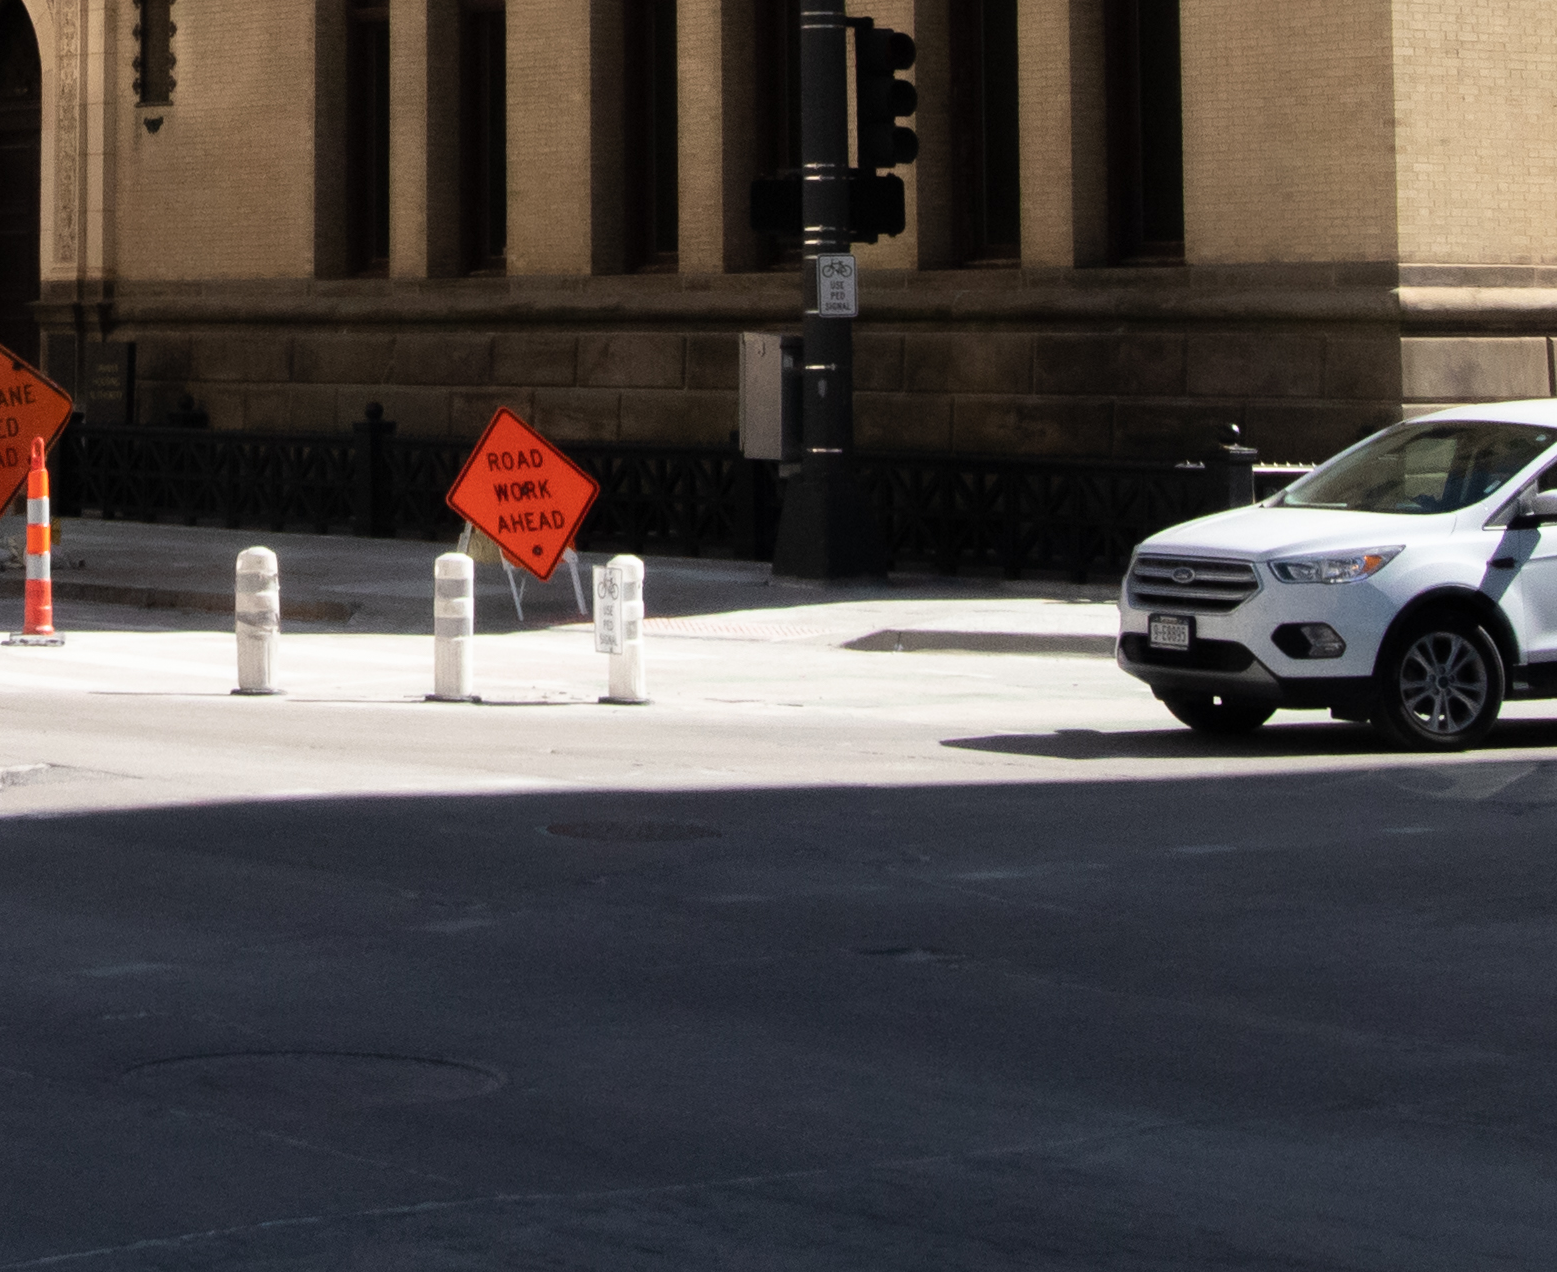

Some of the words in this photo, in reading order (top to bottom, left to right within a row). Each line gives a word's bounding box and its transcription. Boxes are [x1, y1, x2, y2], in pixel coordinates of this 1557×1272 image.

[487, 448, 544, 472] ROAD
[493, 479, 552, 503] WORK
[498, 510, 566, 534] AHEAD
